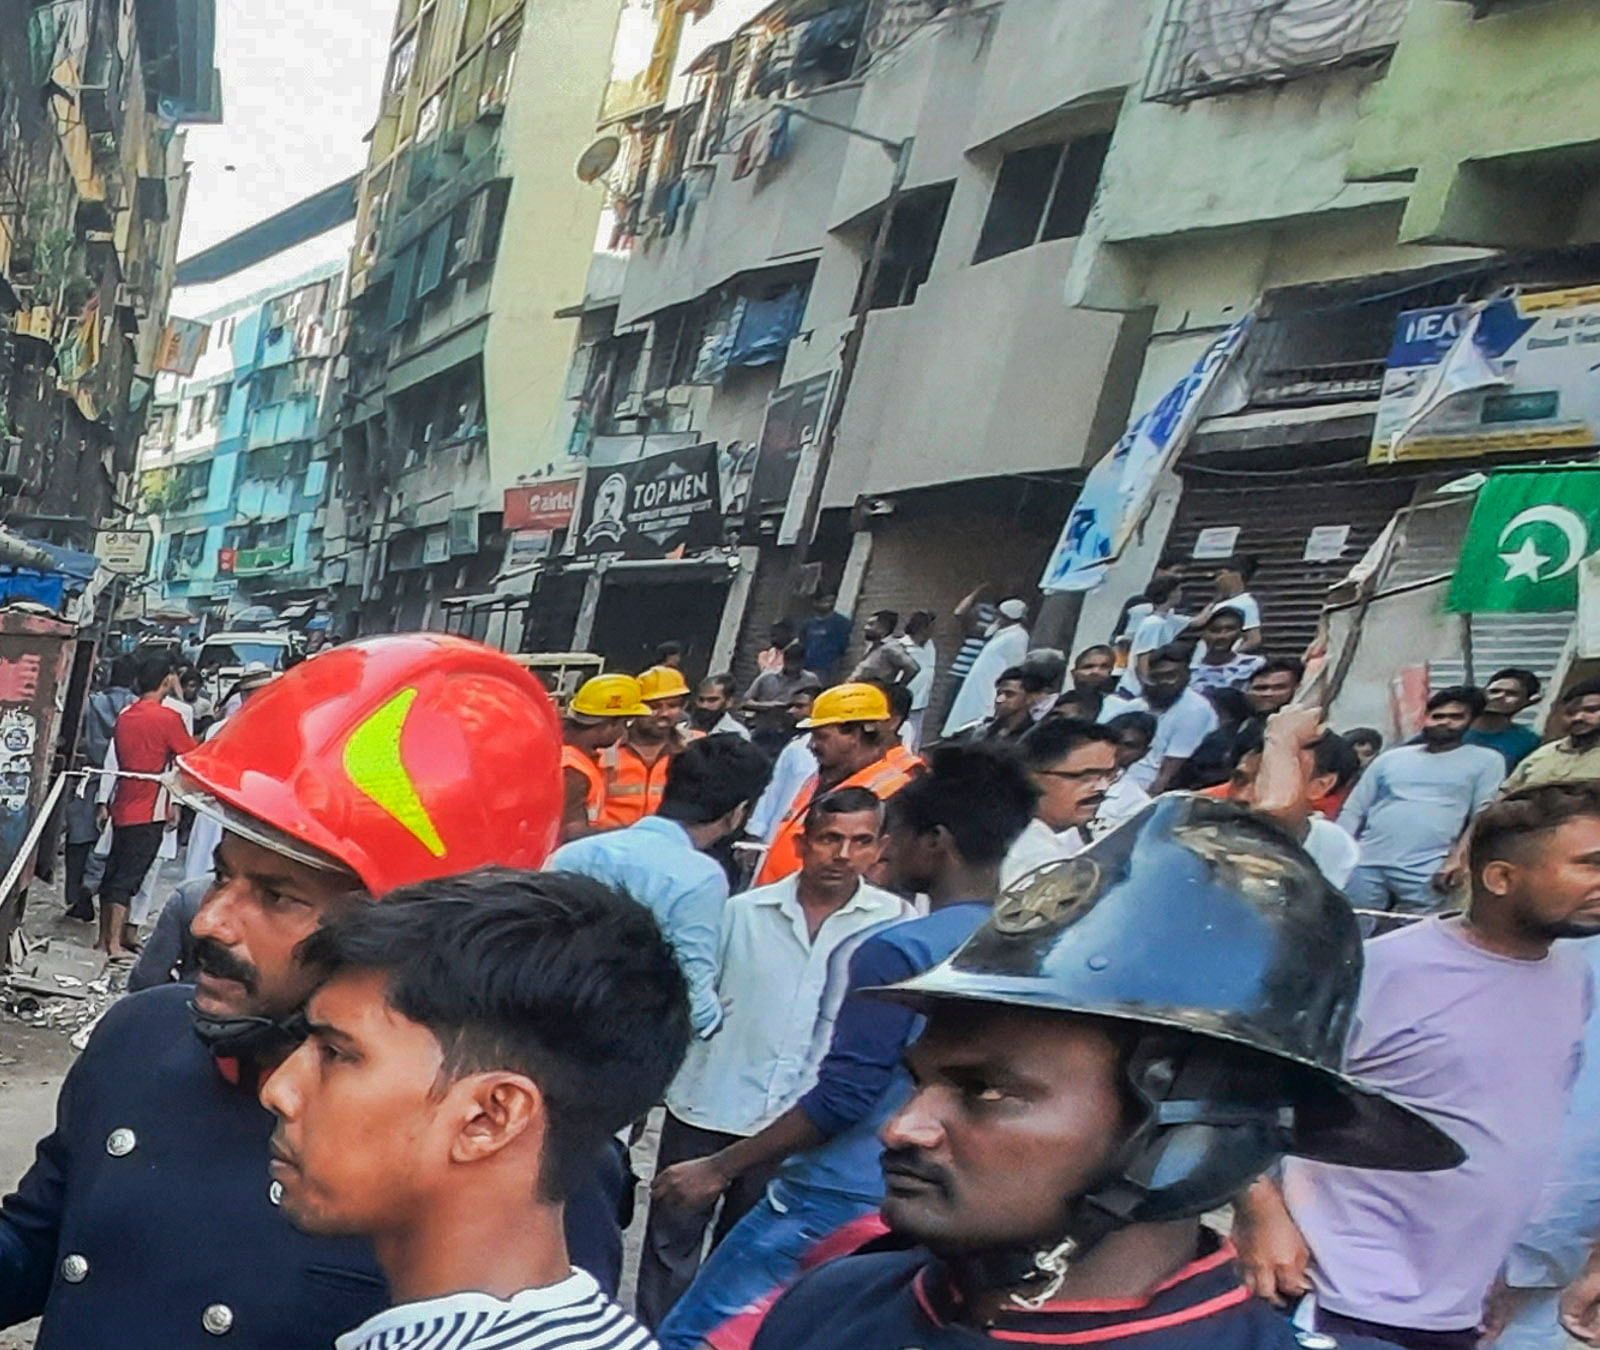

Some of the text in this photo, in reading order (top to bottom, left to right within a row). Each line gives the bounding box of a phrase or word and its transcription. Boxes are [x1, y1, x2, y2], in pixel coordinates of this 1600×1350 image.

[540, 489, 575, 512] airtel
[632, 472, 709, 511] TOP MEN
